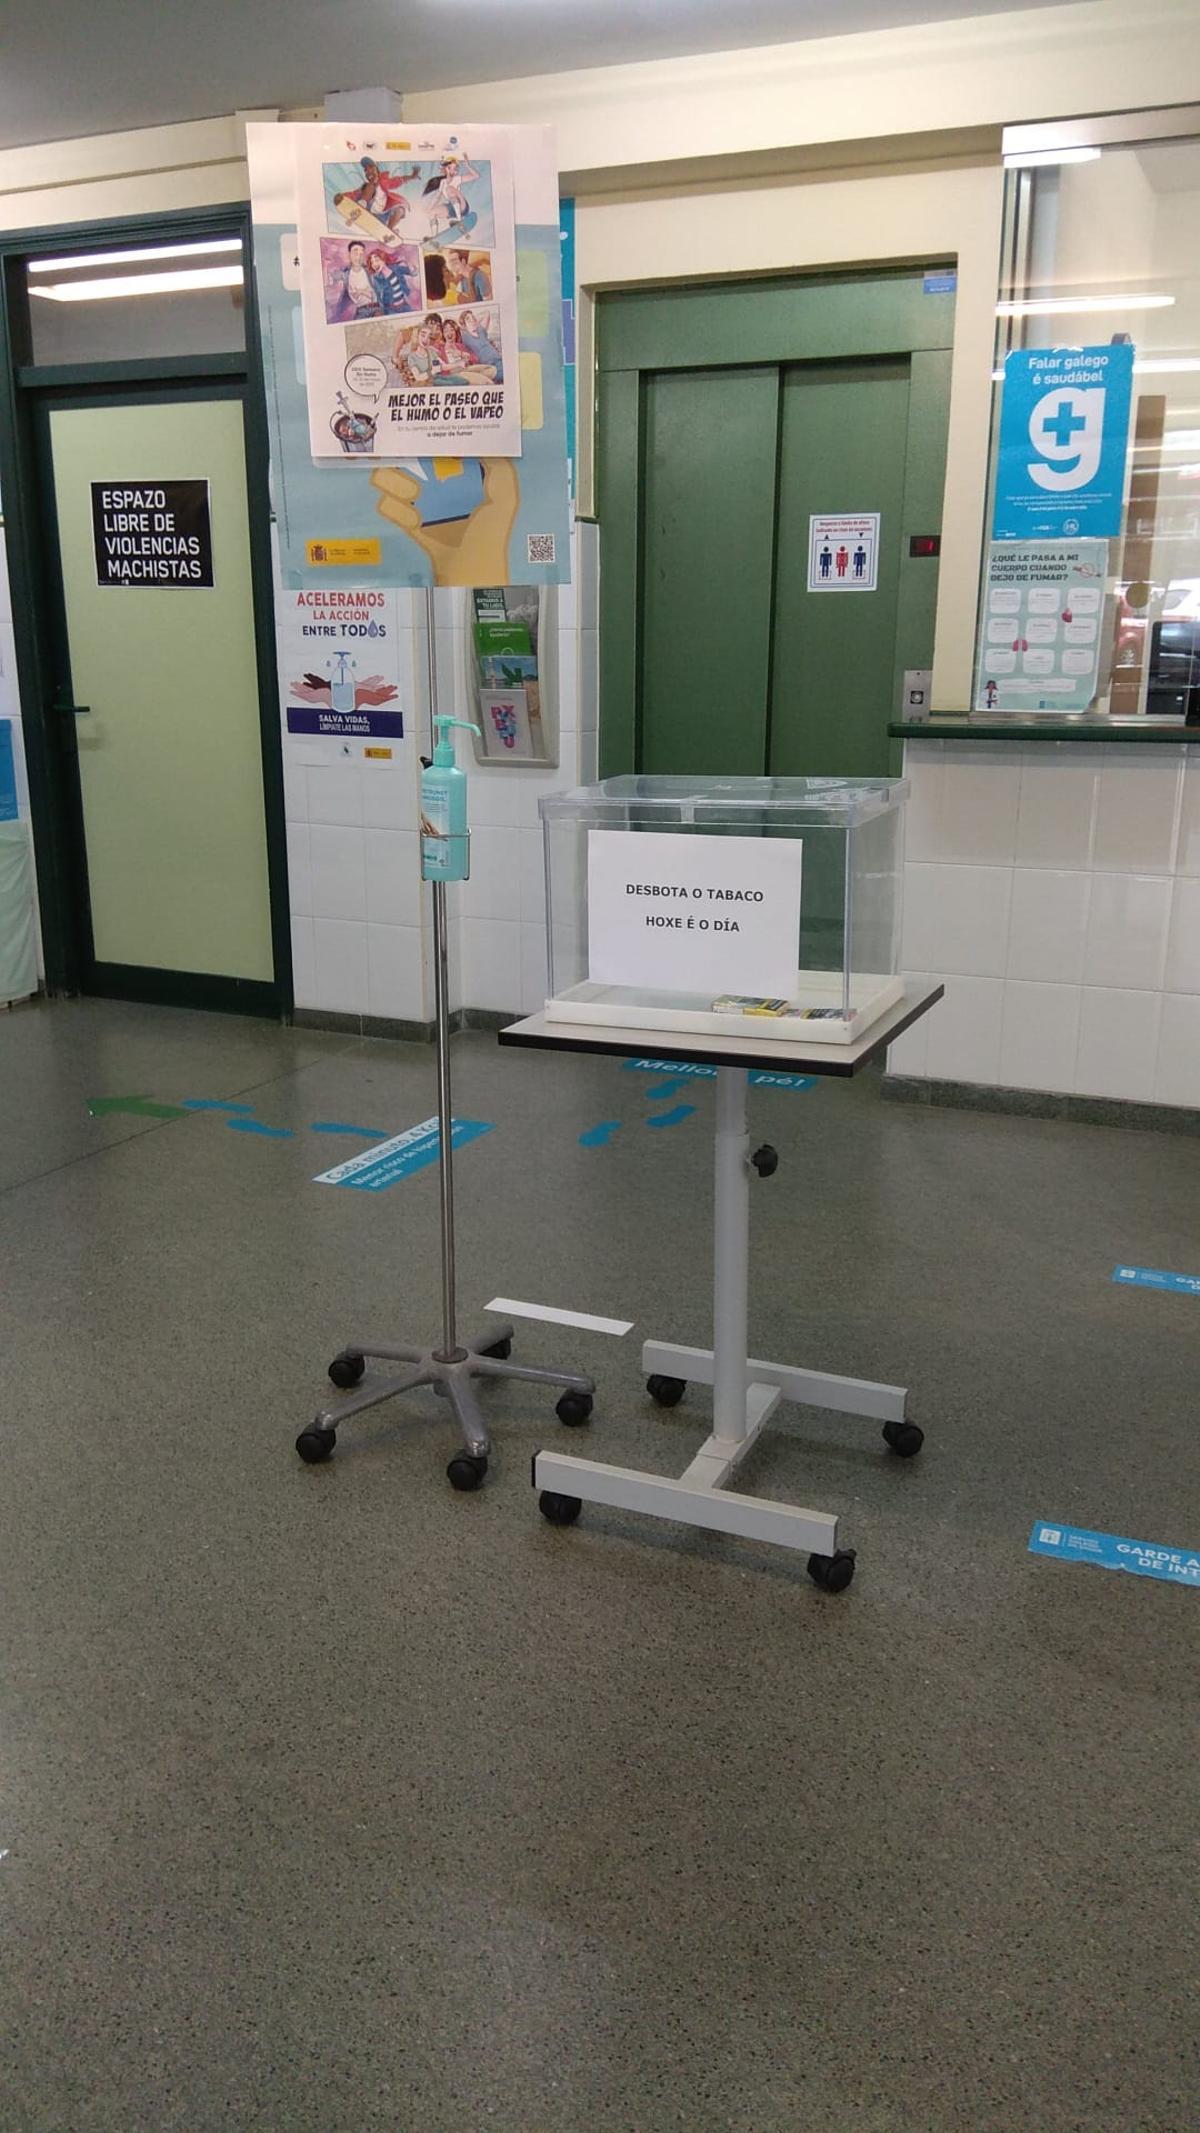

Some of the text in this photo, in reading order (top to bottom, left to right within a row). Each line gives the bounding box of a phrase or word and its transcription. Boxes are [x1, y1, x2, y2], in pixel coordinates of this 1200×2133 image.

[1028, 355, 1109, 371] Falar galego
[1032, 370, 1103, 385] é saudábel
[388, 391, 504, 407] MEJOR EL PASEO QUE
[391, 406, 504, 422] EL HUMO O EL VAPEO
[102, 490, 166, 509] ESPAZO
[104, 513, 175, 532] LIBRE DE
[105, 536, 200, 555] VIOLENCIAS
[1018, 554, 1030, 562] LE
[1031, 554, 1057, 562] PASA
[1058, 554, 1066, 562] A
[107, 559, 202, 578] MACHISTAS
[991, 564, 1028, 572] CUERPO
[990, 574, 1015, 582] DEJO
[297, 592, 385, 607] ACELERAMOS
[313, 610, 326, 620] LA
[302, 625, 336, 637] ENTRE
[319, 714, 370, 724] SALVA VIDAS,
[626, 883, 764, 902] DESBOTA O TABACO
[646, 915, 740, 932] HOXE É O DÍA
[326, 1161, 365, 1180] Cada
[1116, 1543, 1182, 1564] GARDE
[1138, 1557, 1164, 1570] DE
